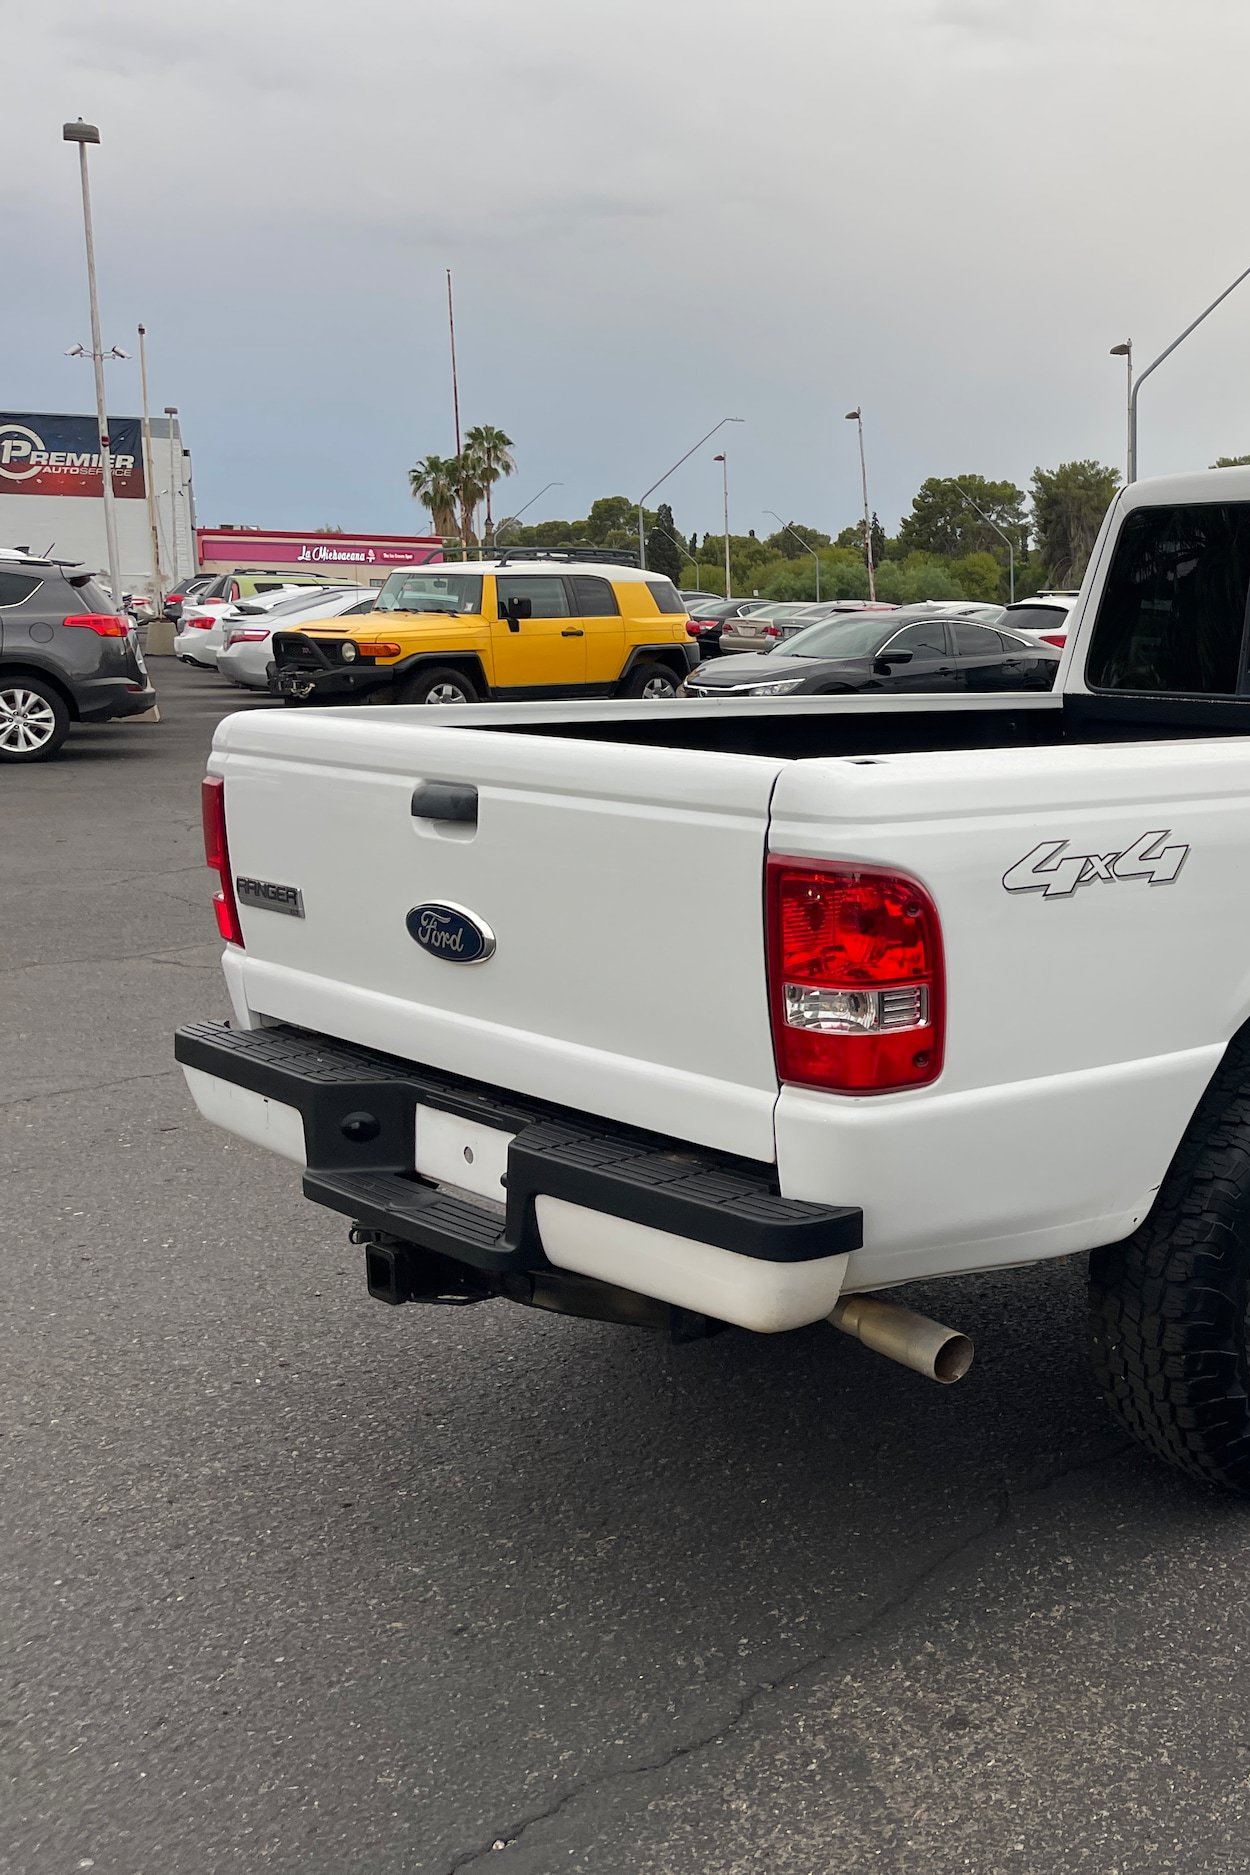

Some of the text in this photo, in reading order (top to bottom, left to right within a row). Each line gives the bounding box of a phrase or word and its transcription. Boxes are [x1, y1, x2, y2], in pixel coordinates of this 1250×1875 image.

[297, 545, 366, 562] La Michoacana
[1002, 829, 1191, 900] 4x4
[237, 877, 298, 906] RANGER
[418, 910, 464, 953] Ford
